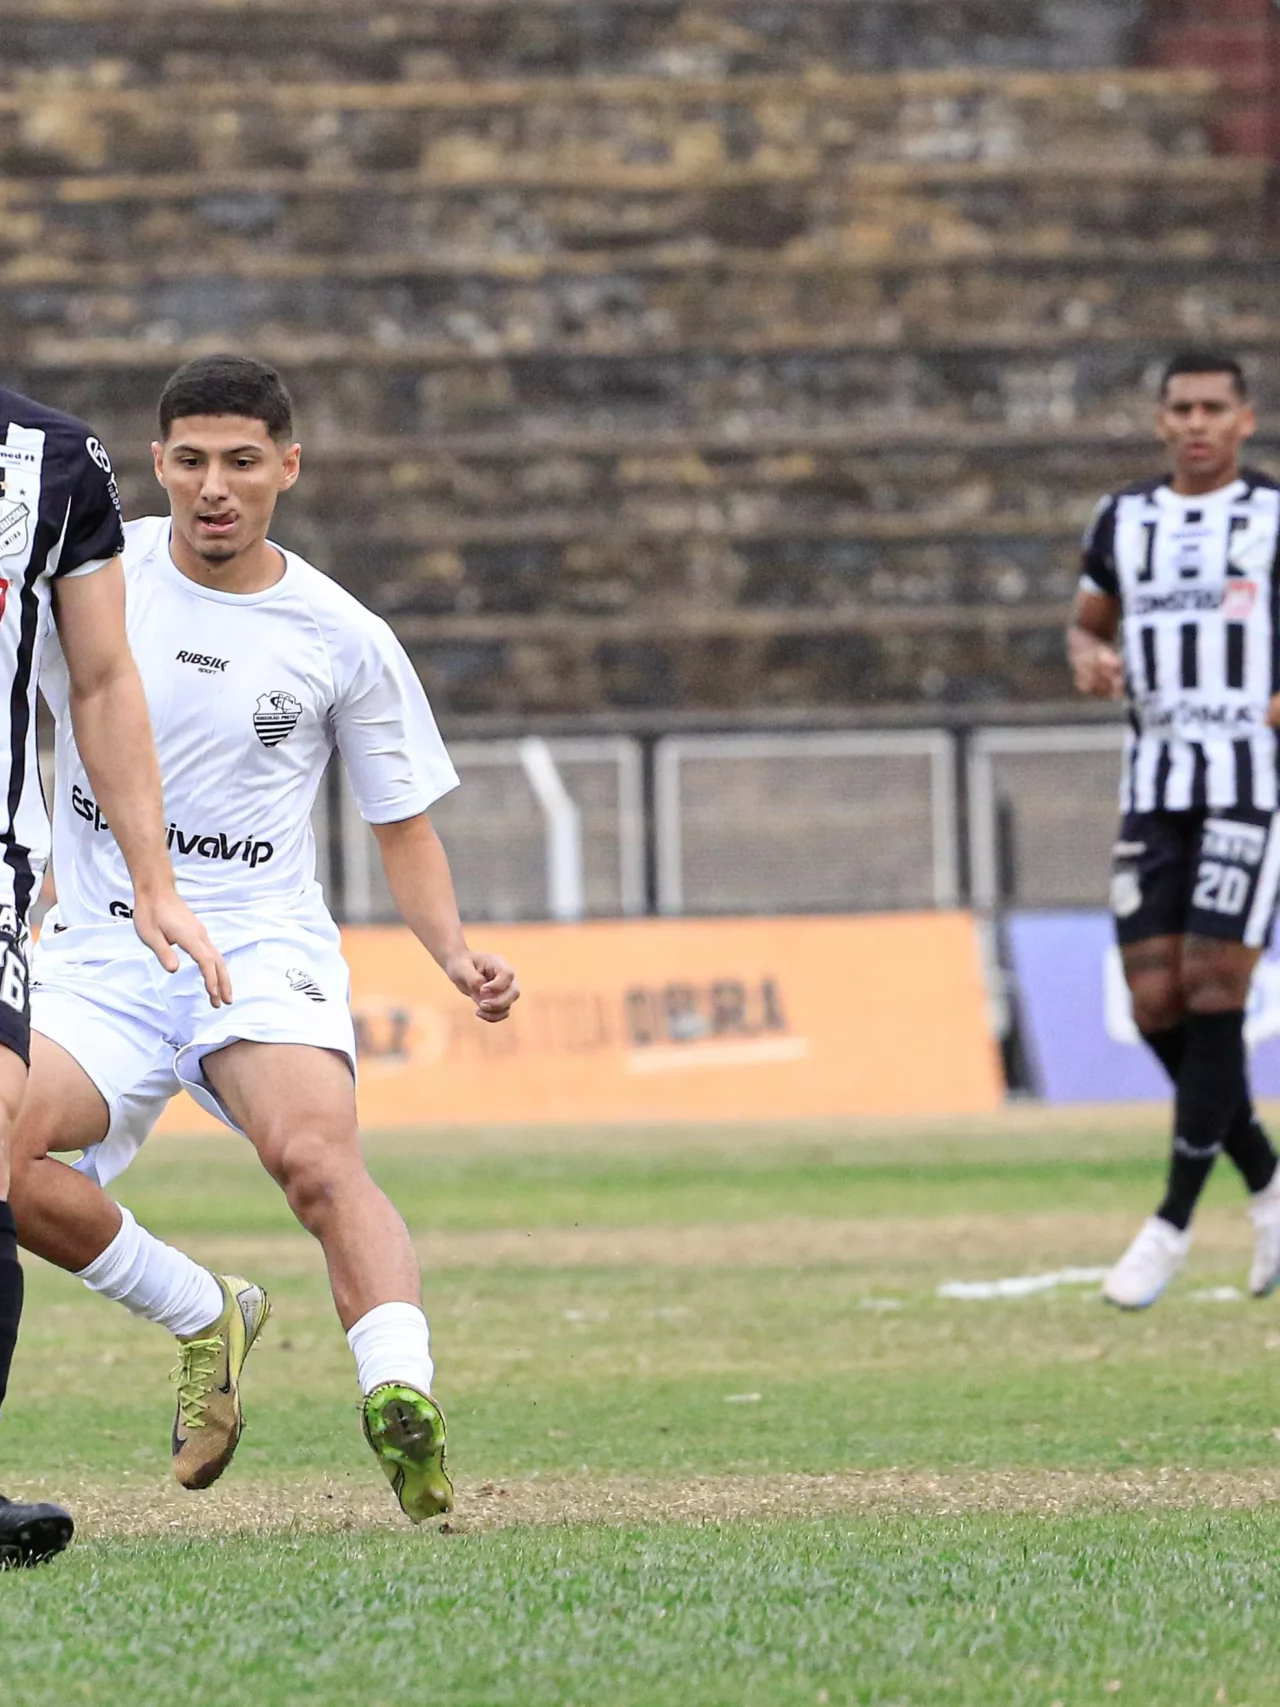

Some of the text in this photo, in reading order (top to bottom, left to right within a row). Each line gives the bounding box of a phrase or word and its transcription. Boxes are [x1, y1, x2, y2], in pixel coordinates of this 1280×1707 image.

[175, 650, 231, 672] RIBSILK
[198, 667, 217, 675] sport
[1191, 861, 1251, 915] 20
